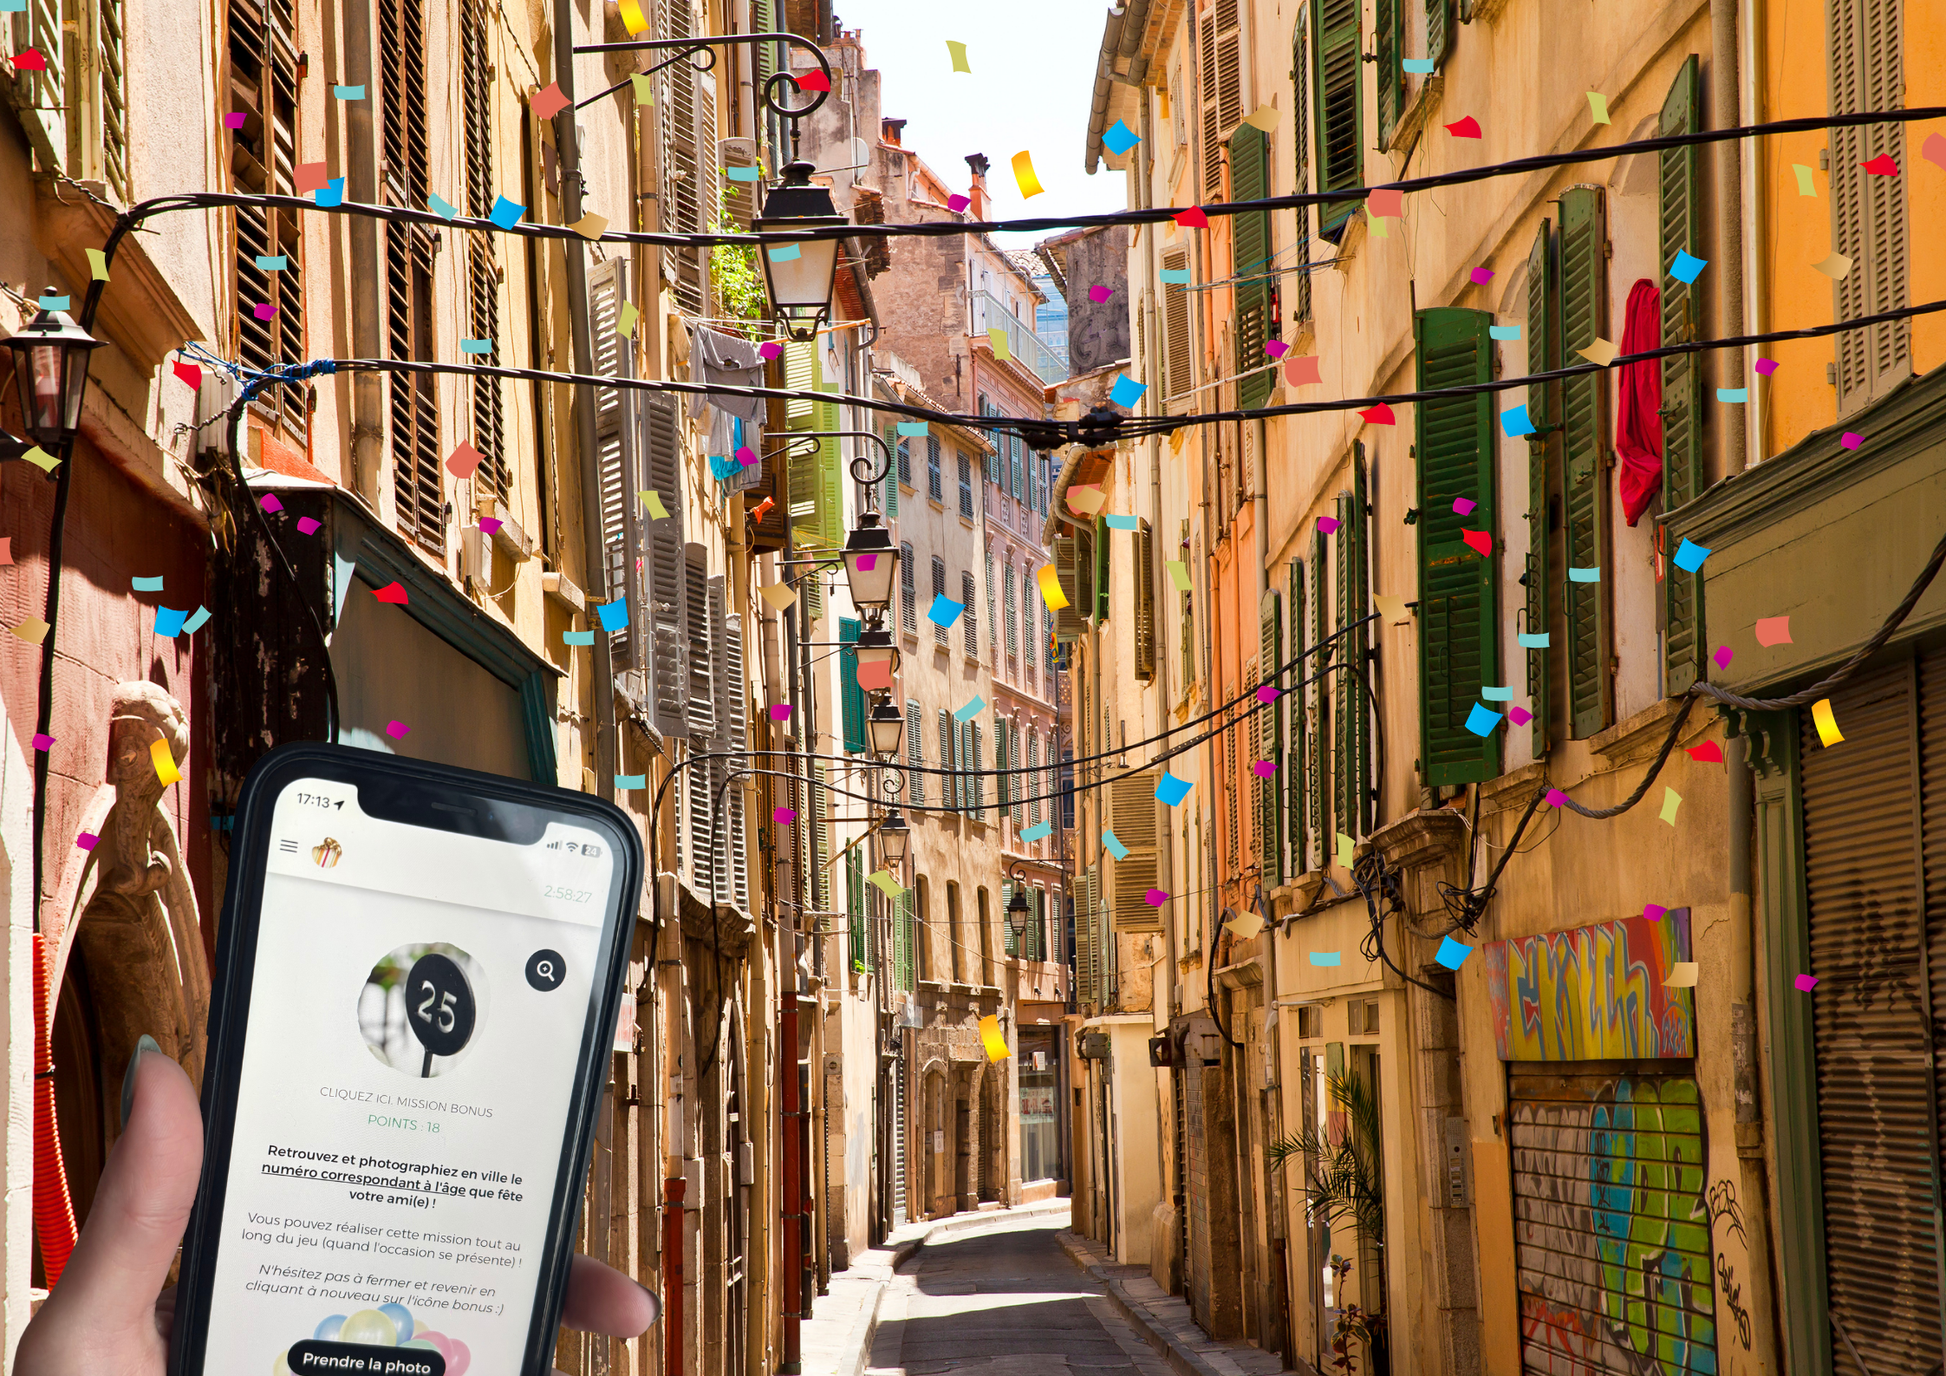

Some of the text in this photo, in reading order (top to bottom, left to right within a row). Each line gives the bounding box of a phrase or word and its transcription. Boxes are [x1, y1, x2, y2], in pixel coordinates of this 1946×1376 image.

[297, 793, 330, 808] 17:13
[584, 846, 598, 856] 24
[544, 885, 592, 904] 2:58:27
[417, 980, 457, 1034] 25
[320, 1086, 494, 1118] CLIQUEZ ICI. MISSION BONUS
[368, 1114, 418, 1131] POINTS
[427, 1122, 440, 1134] 18
[268, 1144, 522, 1185] Retrouvez et photographiez en ville le
[262, 1164, 523, 1202] numéro correspondant à l'âge que fête
[350, 1190, 384, 1202] votre
[386, 1194, 430, 1210] ami(e)
[248, 1212, 520, 1251] Vous pouvez réaliser cette mission tout au
[242, 1228, 272, 1244] long
[276, 1232, 294, 1244] du
[296, 1234, 318, 1248] jeu
[322, 1236, 370, 1252] (quand
[374, 1242, 435, 1258] l'occasion
[438, 1250, 452, 1260] se
[456, 1252, 516, 1268] présente)
[258, 1264, 496, 1297] N'hésitez pas à fermer et revenir en
[246, 1280, 304, 1295] cliquant
[307, 1286, 317, 1296] à
[320, 1288, 380, 1302] nouveau
[383, 1294, 404, 1304] sur
[407, 1294, 449, 1309] l'icône
[452, 1300, 493, 1314] bonus
[303, 1352, 431, 1374] Prendre la photo
